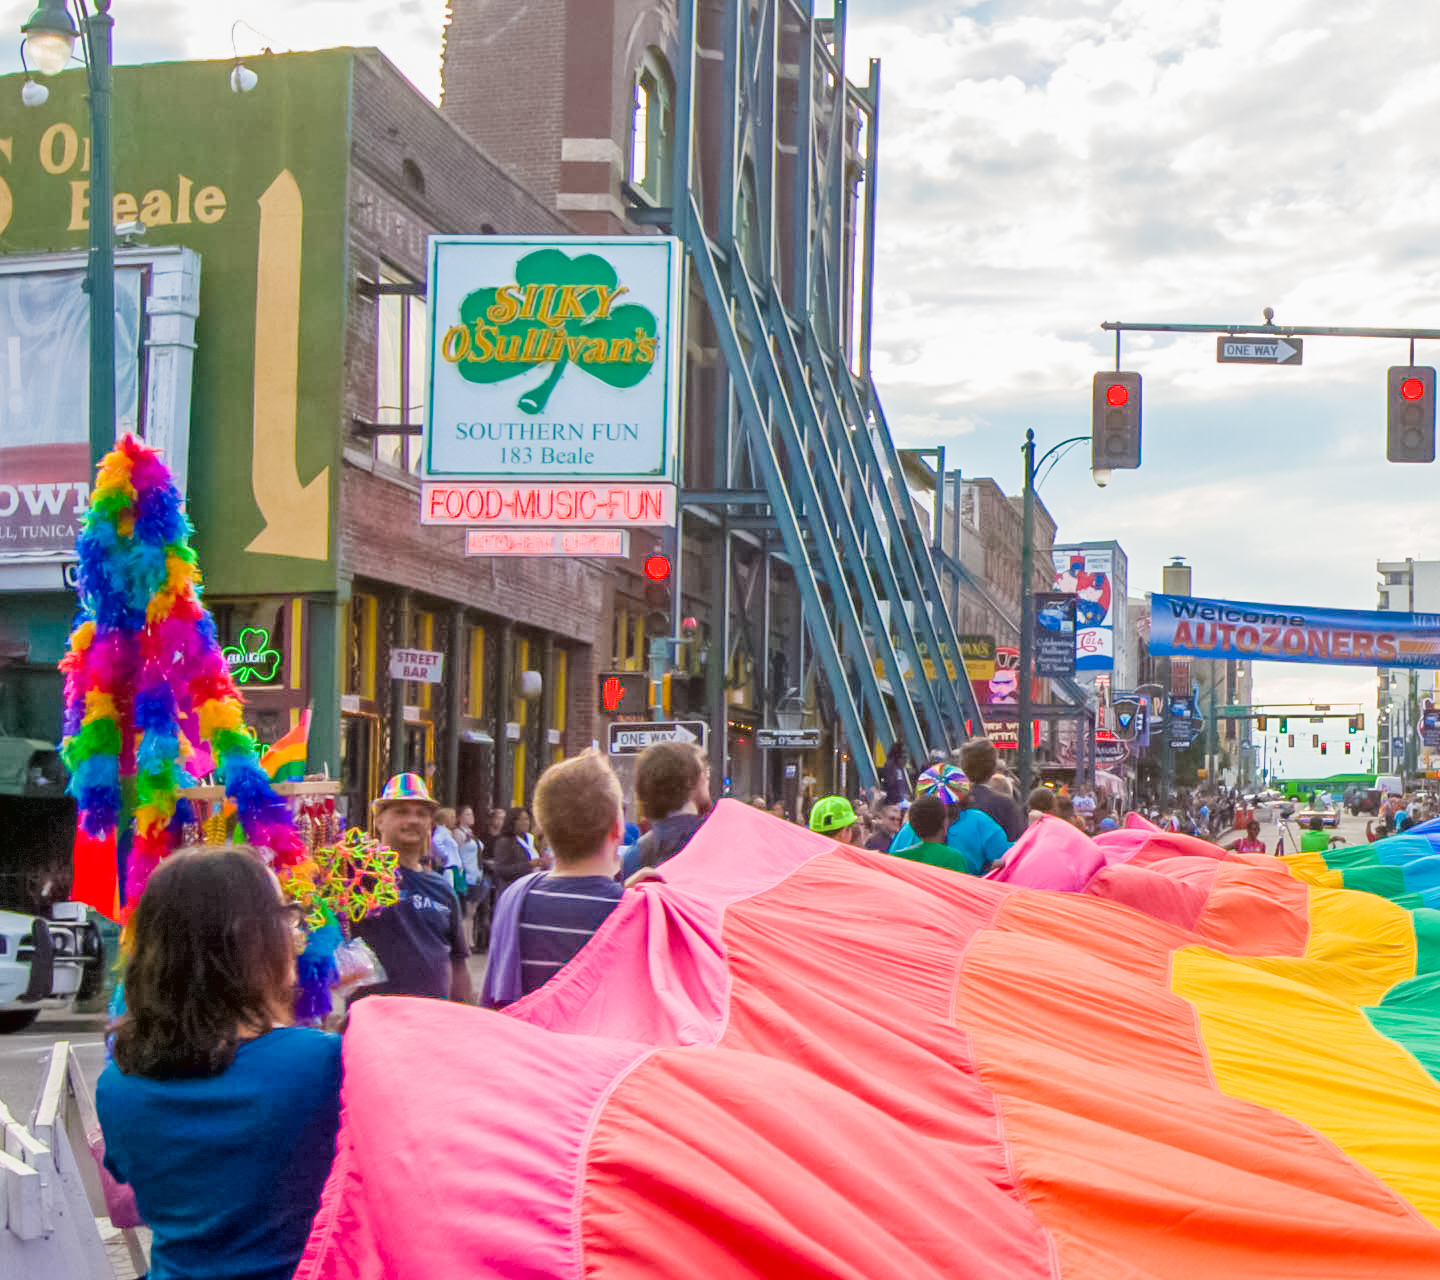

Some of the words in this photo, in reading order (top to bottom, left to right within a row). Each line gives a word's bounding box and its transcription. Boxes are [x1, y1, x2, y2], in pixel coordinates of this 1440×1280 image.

[487, 283, 629, 327] SILKY
[442, 318, 657, 364] O'Sullivan's
[1227, 345, 1251, 356] ONE
[1254, 346, 1278, 356] WAY
[455, 423, 584, 441] SOUTHERN
[592, 423, 639, 441] FUN
[500, 447, 533, 464] 183
[541, 447, 595, 464] Beale
[21, 524, 75, 540] TUNICA
[1170, 600, 1306, 626] Welcome
[1172, 620, 1397, 660] AUTOZONERS
[396, 651, 440, 667] STREET
[403, 665, 428, 680] BAR
[620, 733, 645, 746] ONE
[651, 731, 677, 744] WAY
